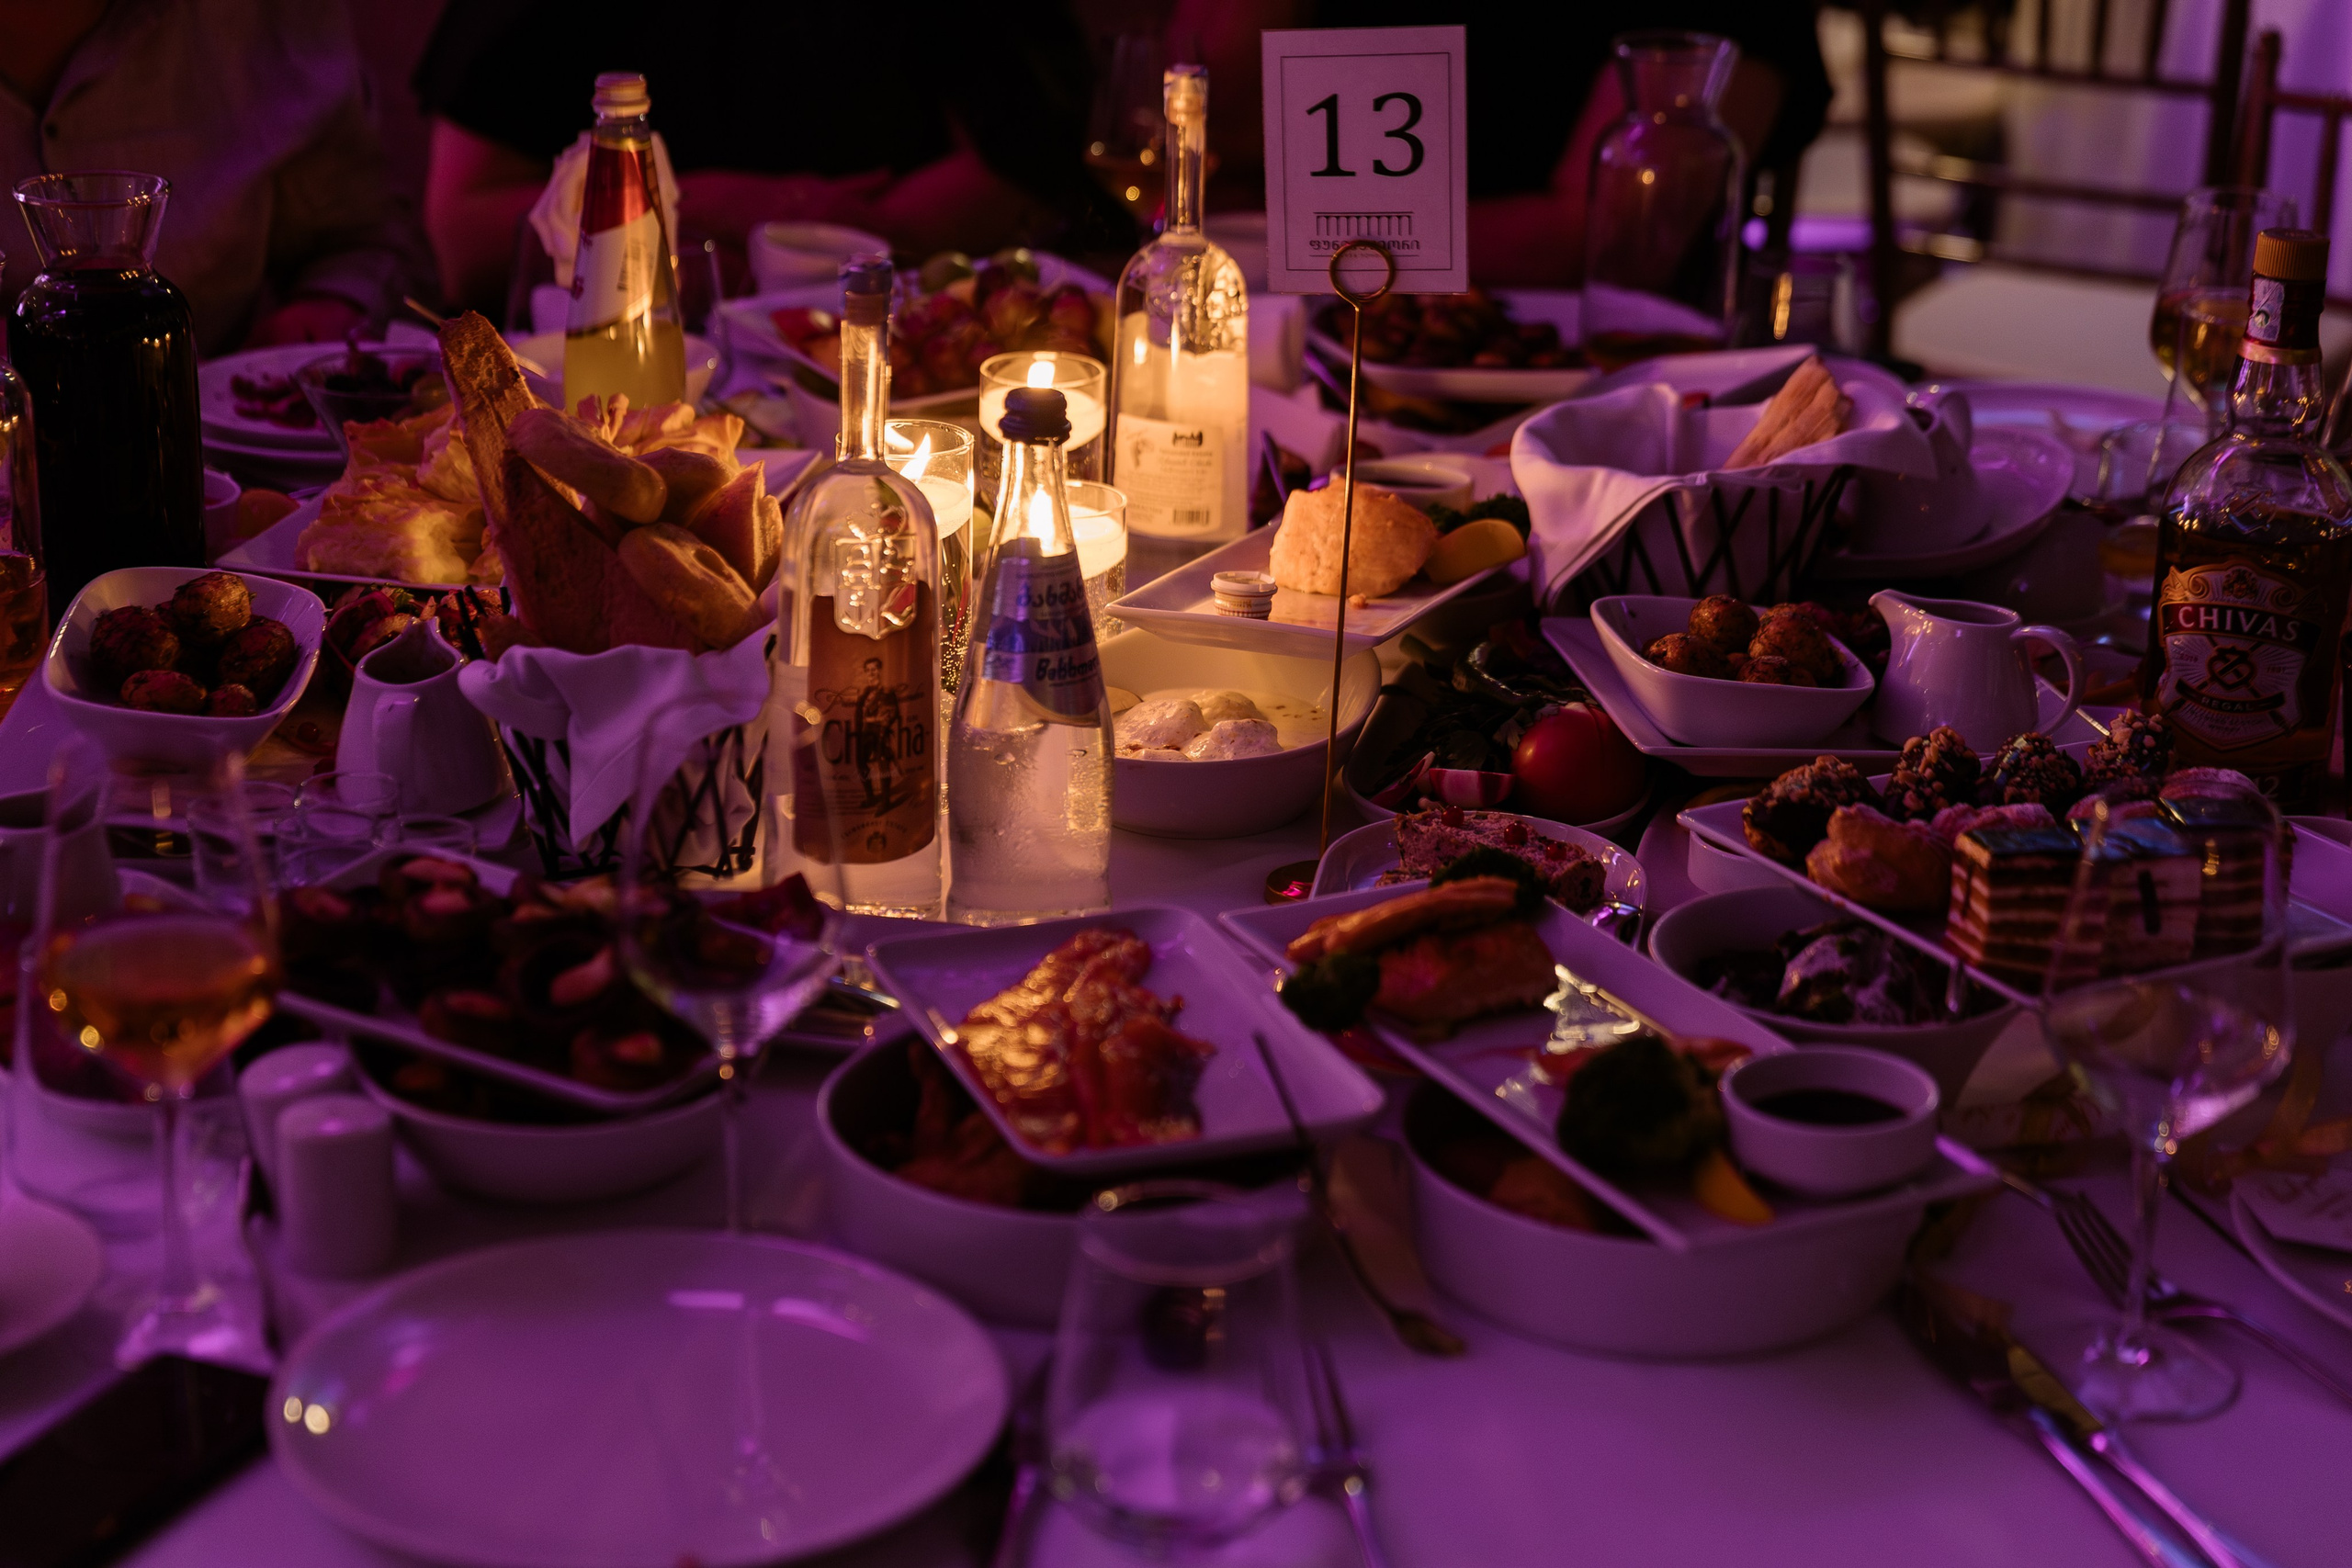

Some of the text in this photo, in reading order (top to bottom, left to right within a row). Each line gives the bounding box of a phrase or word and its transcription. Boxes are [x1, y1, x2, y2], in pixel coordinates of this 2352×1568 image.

[1306, 92, 1425, 177] 13
[2177, 606, 2301, 643] CHIVAS
[1035, 655, 1099, 681] Bakhmar
[2200, 696, 2255, 713] REGAL
